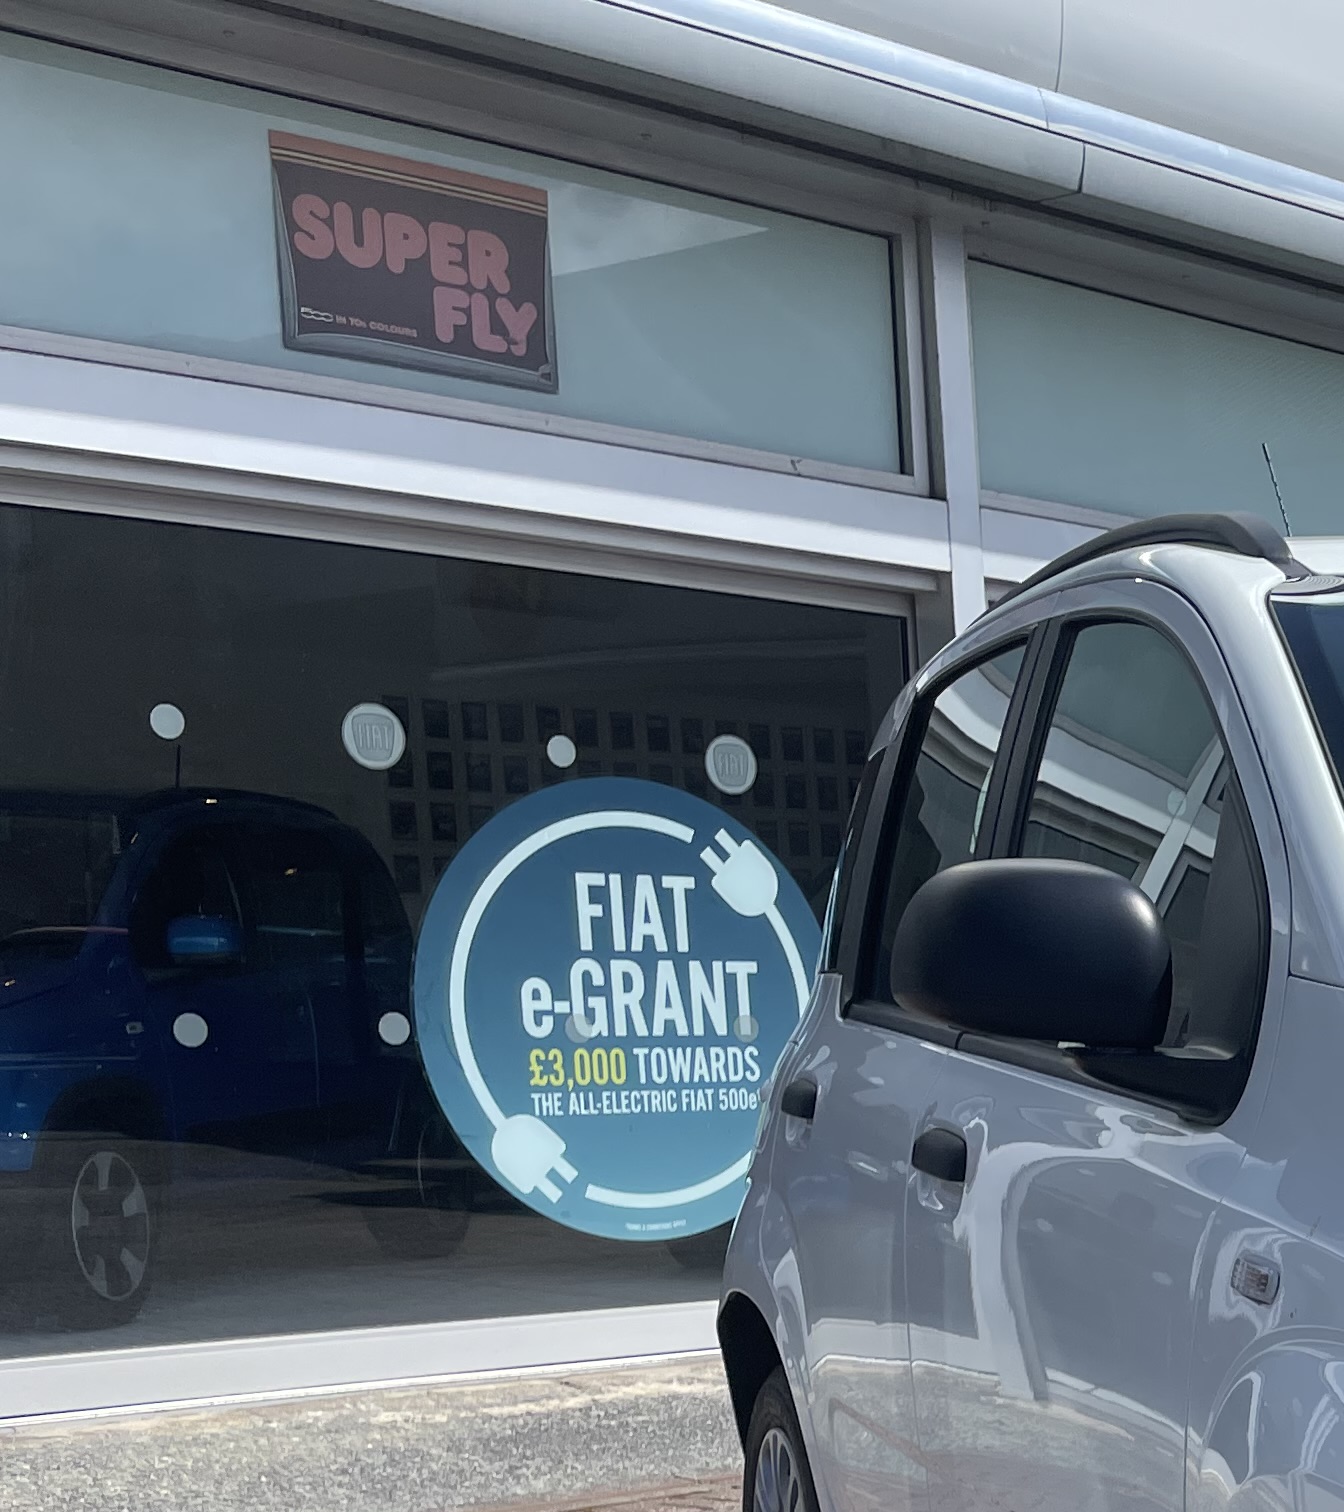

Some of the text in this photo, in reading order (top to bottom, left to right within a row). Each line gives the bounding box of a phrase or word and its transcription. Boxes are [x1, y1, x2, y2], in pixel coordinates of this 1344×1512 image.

[292, 193, 511, 295] SUPER
[433, 285, 538, 357] FLY
[357, 722, 392, 751] FIAT
[718, 750, 745, 777] FIAT
[575, 871, 695, 953] FIAT
[520, 957, 758, 1039] e-GRANT
[529, 1046, 761, 1090] £3,000 TOWARDS
[531, 1092, 564, 1117] THE
[569, 1090, 677, 1116] ALL-ELECTRIC
[681, 1089, 713, 1112] FIAT
